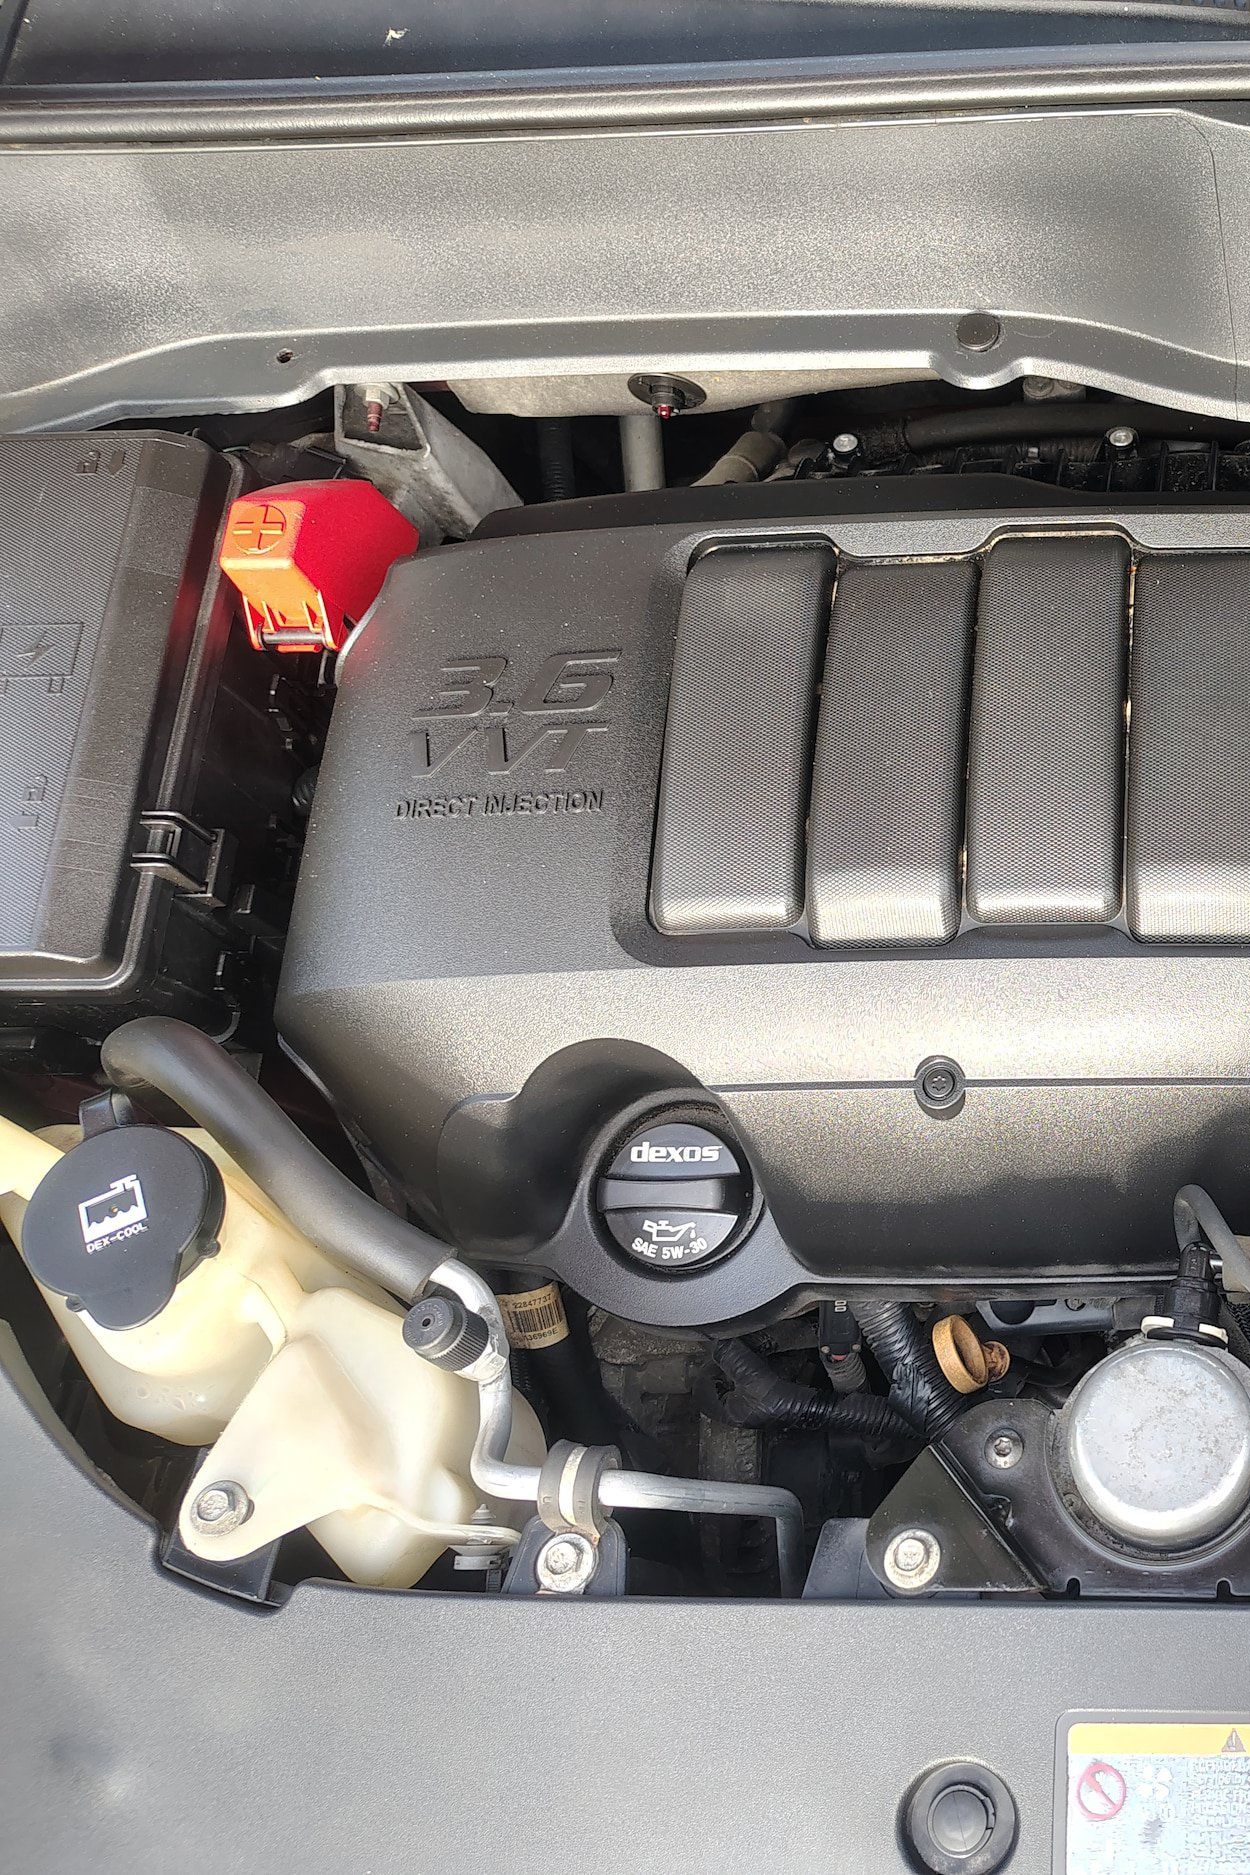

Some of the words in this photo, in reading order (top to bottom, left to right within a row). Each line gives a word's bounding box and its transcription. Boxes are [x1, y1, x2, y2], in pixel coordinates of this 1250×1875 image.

[411, 648, 623, 720] 3.6
[408, 720, 612, 779] VVT
[394, 796, 478, 821] DIRECT
[484, 790, 605, 816] INJECTION
[630, 1141, 723, 1163] dexos
[86, 1222, 149, 1254] DEX-COOL
[631, 1237, 659, 1259] SAE
[661, 1237, 708, 1260] 5W-30
